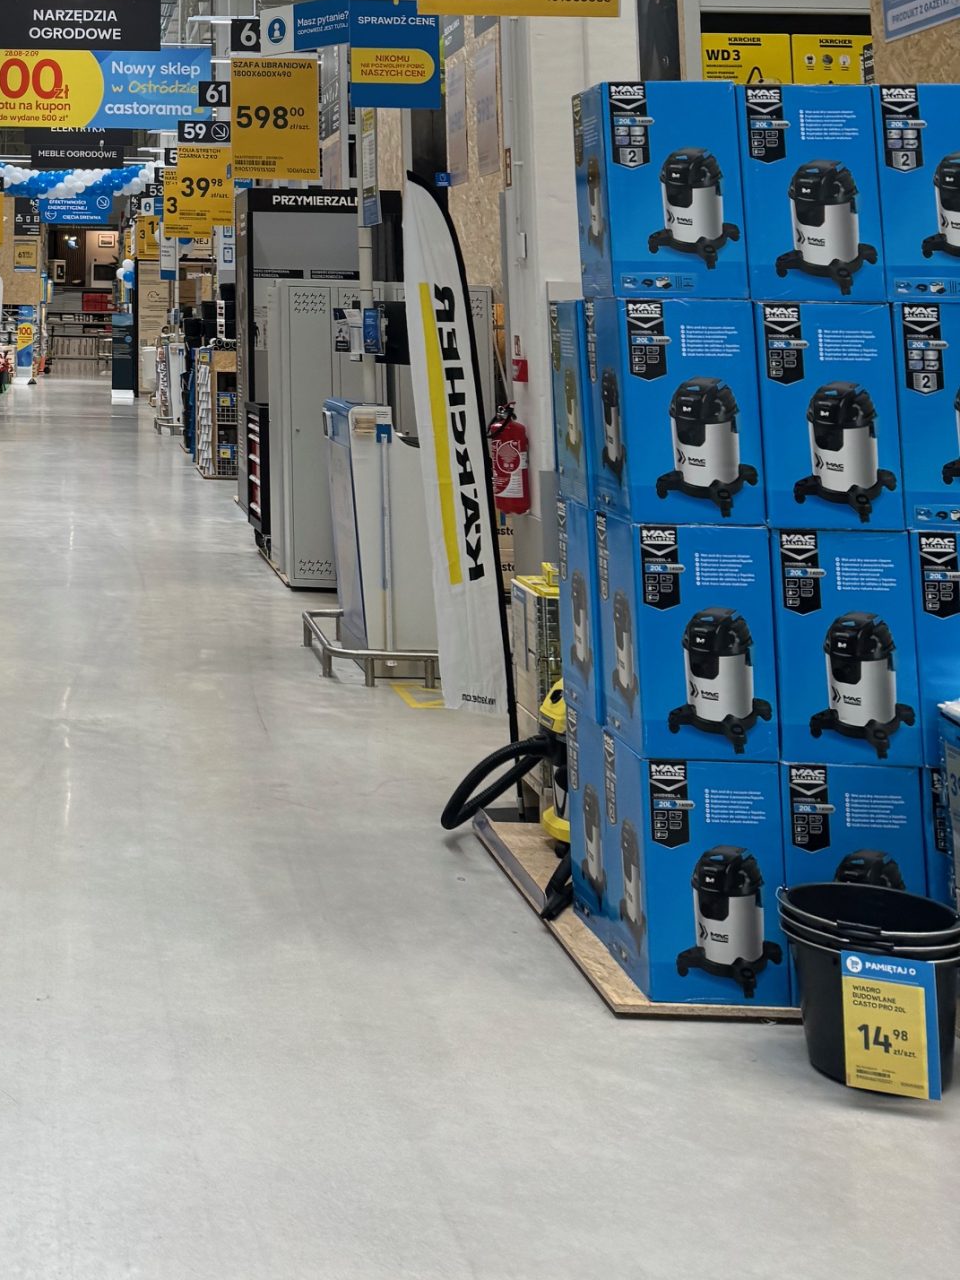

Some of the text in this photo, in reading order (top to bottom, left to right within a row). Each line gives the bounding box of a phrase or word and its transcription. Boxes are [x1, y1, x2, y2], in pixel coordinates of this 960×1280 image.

[33, 9, 118, 24] NARZĘDZIA
[297, 11, 349, 27] Masz pytanie?
[358, 15, 436, 27] SPRAWDŹ CENĘ
[28, 27, 121, 40] OGRODOWE
[376, 55, 410, 63] NIKOMU
[706, 50, 741, 61] WD 3
[111, 61, 200, 79] Nowy sklep
[361, 69, 403, 77] NASZYCH
[54, 85, 69, 99] zł
[112, 80, 199, 94] w Ostródzie
[610, 85, 644, 93] MAC
[747, 89, 780, 97] MAC
[205, 84, 228, 104] 61
[19, 102, 31, 110] na
[35, 100, 70, 113] kupon
[105, 101, 192, 116] castorama
[10, 114, 40, 122] wydane
[237, 106, 288, 129] 598
[290, 107, 304, 117] 00
[184, 124, 206, 139] 59
[38, 150, 117, 158] MEBLE OGRODOWE
[149, 186, 164, 196] 53
[181, 177, 210, 198] 39
[627, 303, 661, 312] MAC
[903, 307, 938, 316] MAC
[641, 529, 675, 538] MAC
[865, 962, 916, 976] PAMIĘTAJ O
[852, 984, 881, 994] WIADRO
[852, 992, 897, 1004] BUDOWLANE
[853, 999, 906, 1014] CASTO PRO 20L
[857, 1024, 893, 1053] 14
[893, 1029, 909, 1042] 98
